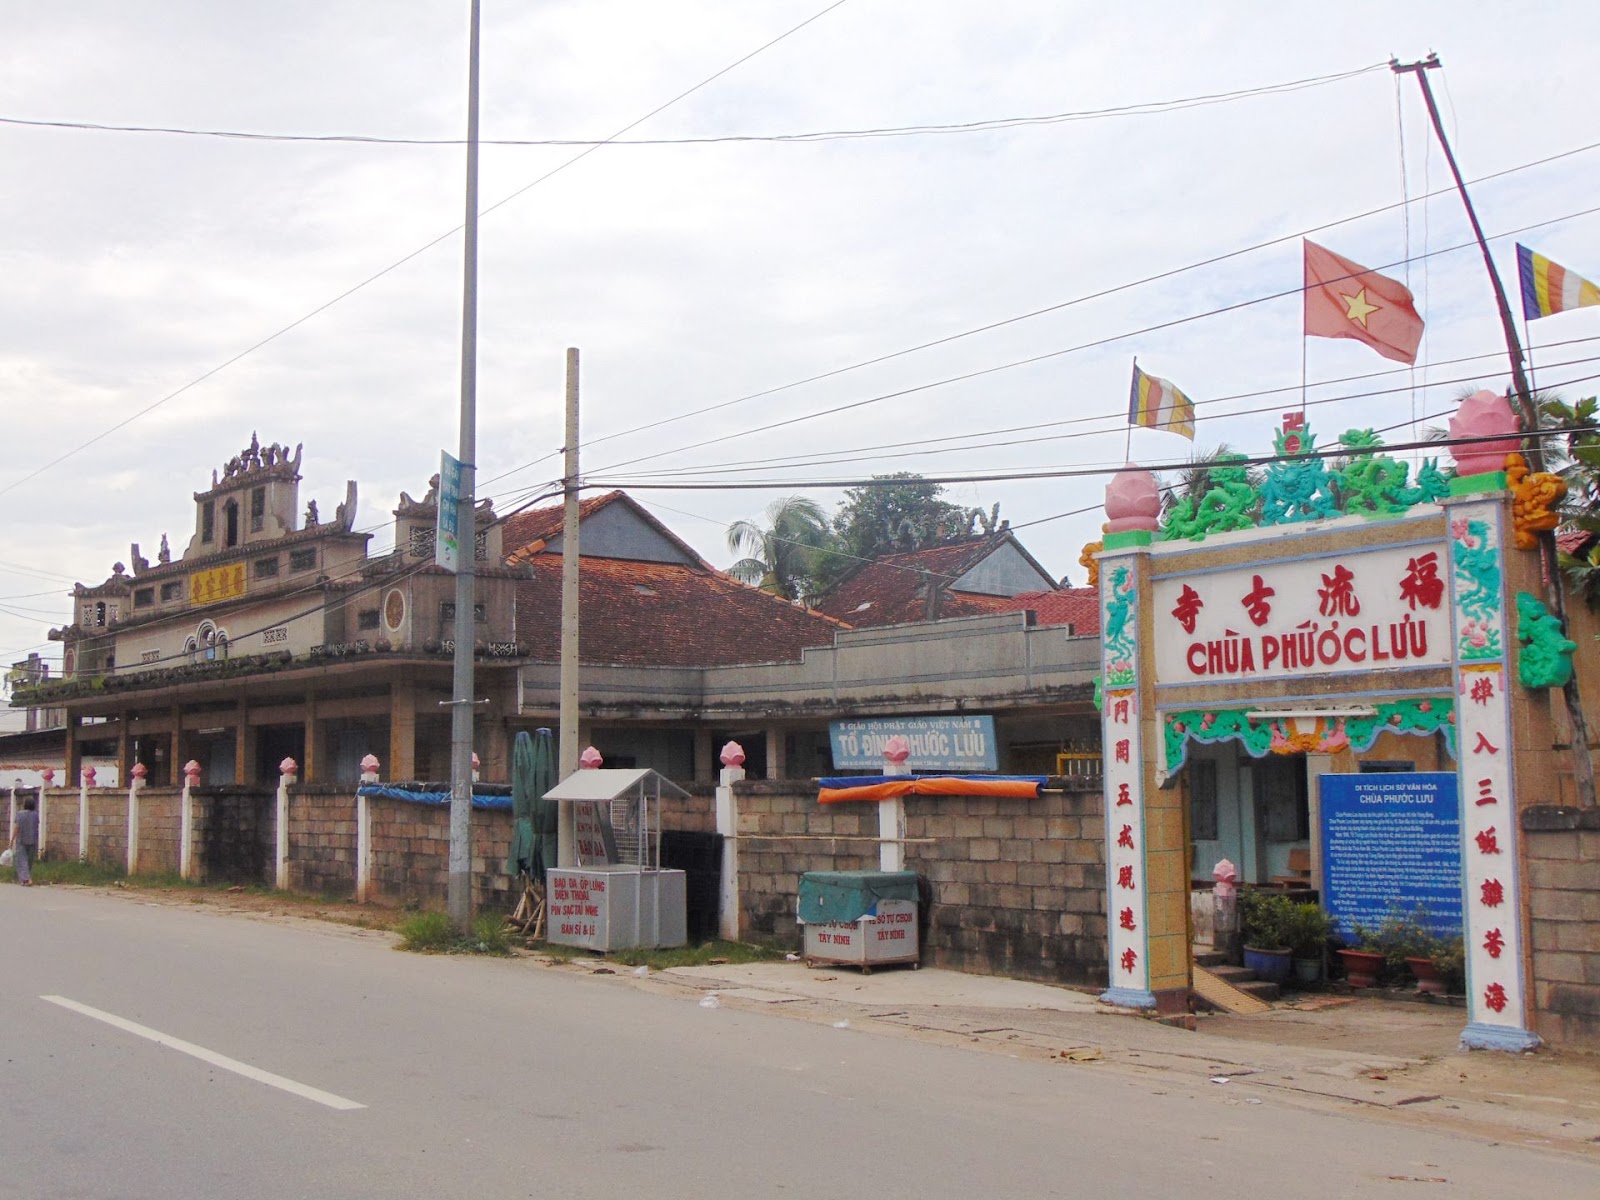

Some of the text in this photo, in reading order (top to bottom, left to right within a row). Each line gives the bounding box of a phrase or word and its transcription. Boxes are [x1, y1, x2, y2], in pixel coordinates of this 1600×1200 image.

[1187, 629, 1256, 675] CHÙA
[1372, 614, 1428, 661] LƯU
[848, 719, 971, 731] GIÁO HỘI PHẬT GIÁO VIỆT NAM
[839, 730, 859, 757] TỔ
[861, 731, 889, 757] ĐÌN
[953, 730, 985, 757] LƯU
[1380, 784, 1395, 792] LỊCH
[1360, 793, 1434, 804] CHÙA PHƯỚC LƯU
[583, 924, 588, 935] &
[877, 928, 889, 941] TÂY
[818, 930, 831, 943] TÂY
